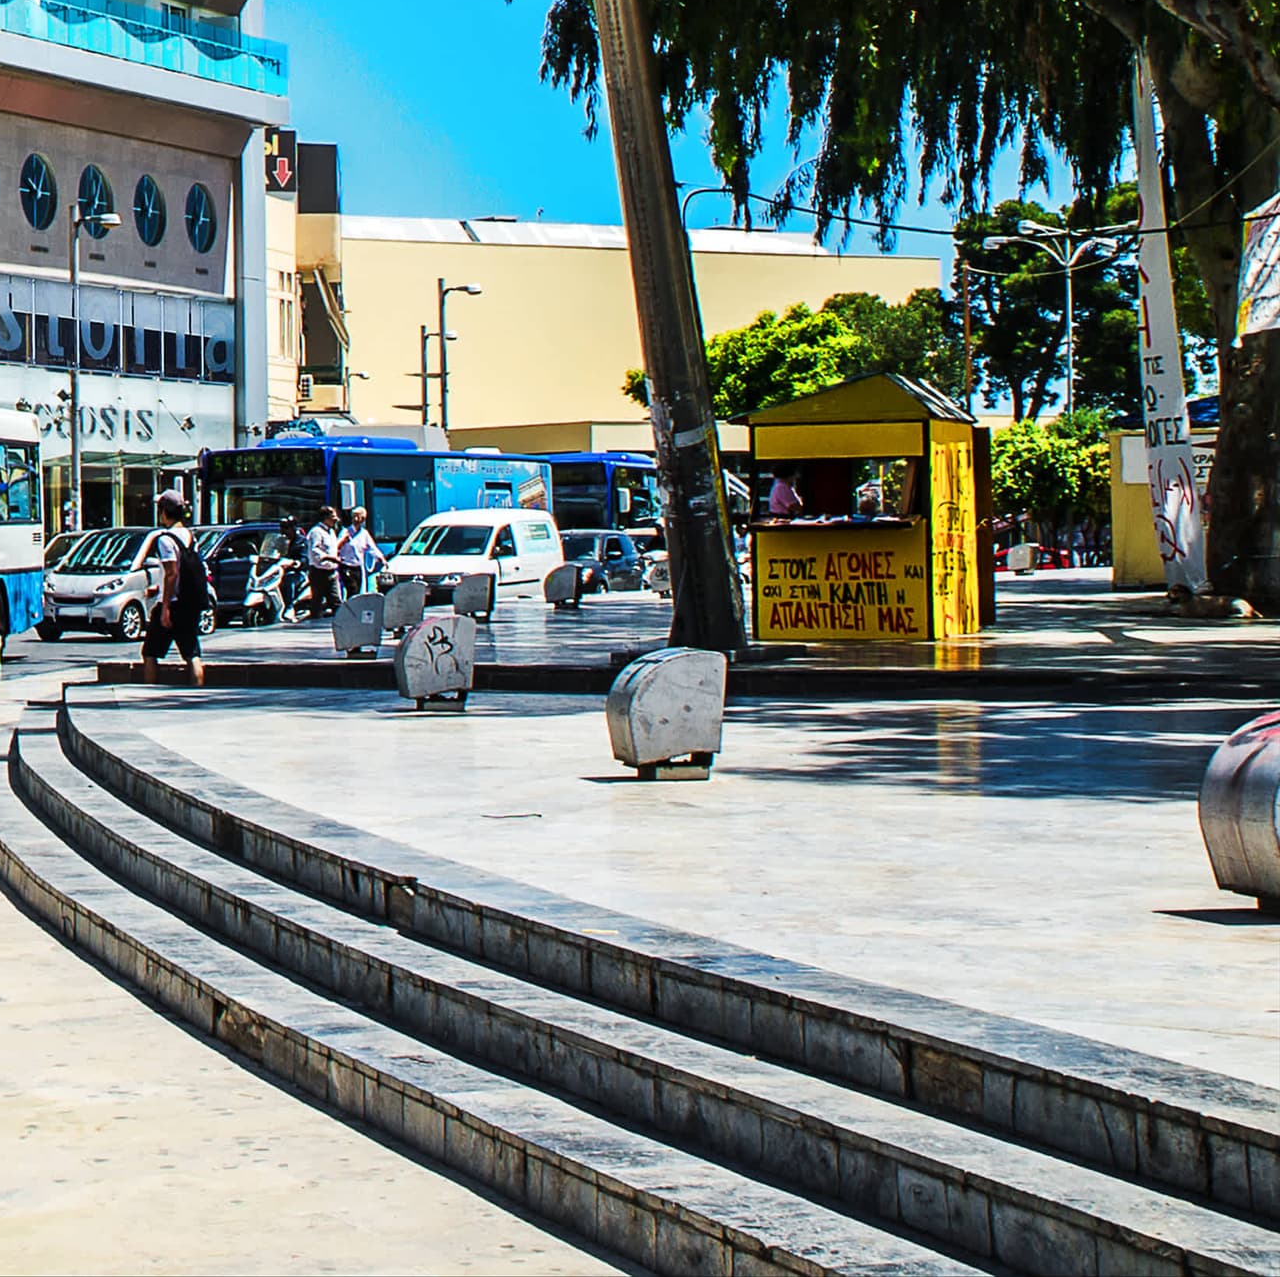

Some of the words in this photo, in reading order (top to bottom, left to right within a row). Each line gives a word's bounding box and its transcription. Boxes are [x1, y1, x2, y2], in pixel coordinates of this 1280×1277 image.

[768, 557, 817, 580] ΣΤΟΥΣ
[825, 551, 896, 580] ΑΓΩΝΕΣ
[904, 565, 924, 579] ΚΑΙ
[830, 582, 888, 606] ΚΑΛΠΗ
[770, 602, 866, 631] ΑΠΑΝΤΗΣΗ
[878, 607, 919, 634] ΜΑΣ
